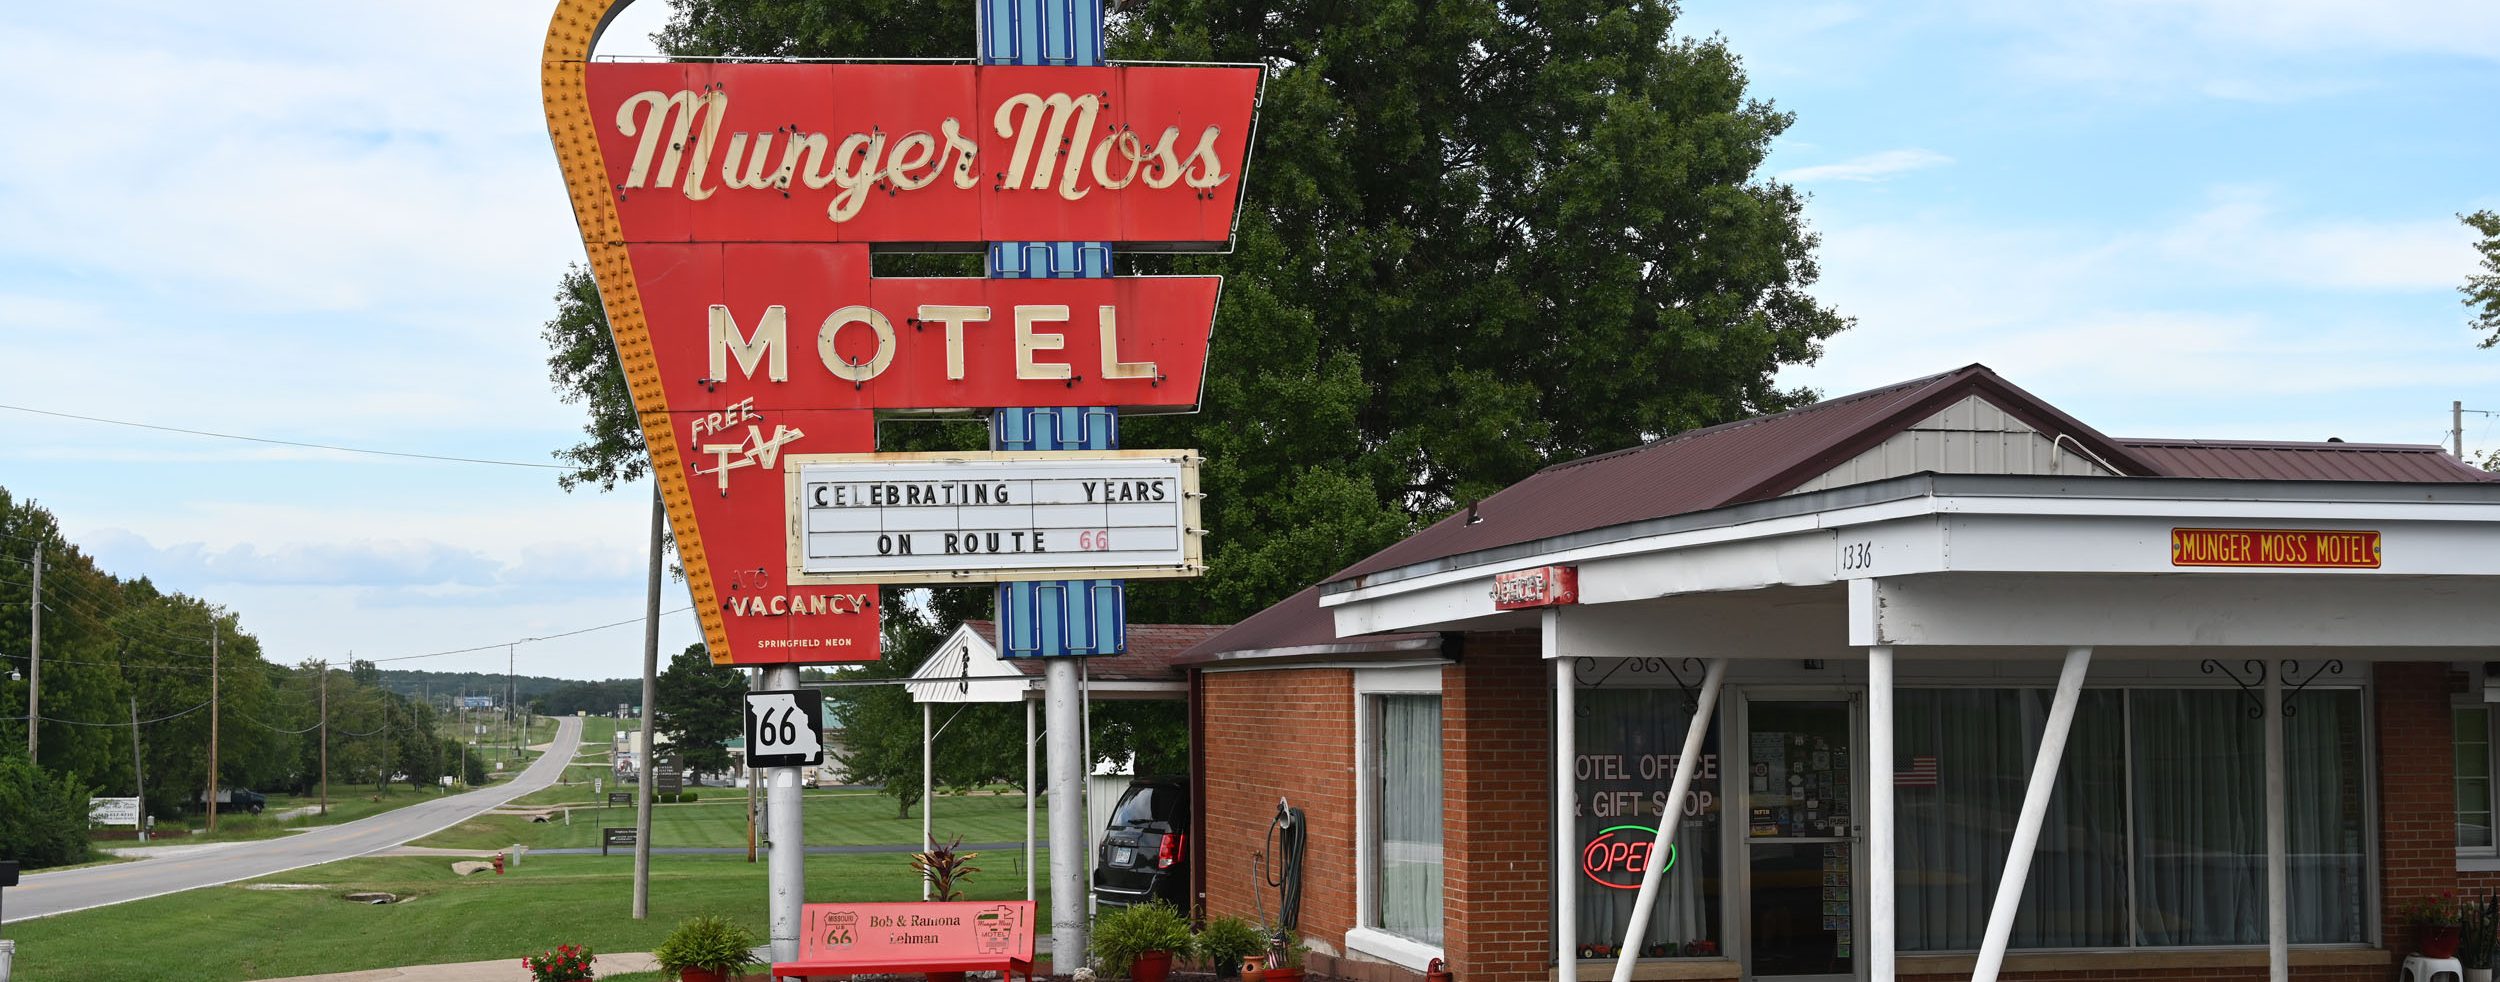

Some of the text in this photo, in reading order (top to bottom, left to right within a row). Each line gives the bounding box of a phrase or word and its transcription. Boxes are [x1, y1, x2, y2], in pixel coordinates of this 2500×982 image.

[615, 89, 1232, 223] Munger Moss
[707, 304, 1158, 382] MOTEL
[692, 396, 754, 440] FREE
[703, 424, 788, 489] TV
[814, 481, 1165, 507] CELEBRATING YEARS
[877, 530, 1108, 555] ON ROUTE 66
[1842, 540, 1872, 570] 1336
[2182, 533, 2371, 563] MUNGER MOSS MOTEL
[730, 594, 867, 617] VACANCY
[758, 638, 852, 648] SPRINGFIELD NEON
[760, 706, 796, 747] 66
[1575, 754, 1718, 781] OTEL OFFCE
[1592, 791, 1643, 818] GIFT
[1652, 790, 1713, 817] SOP
[870, 915, 961, 928] Bob & Ramona
[827, 929, 852, 945] 66
